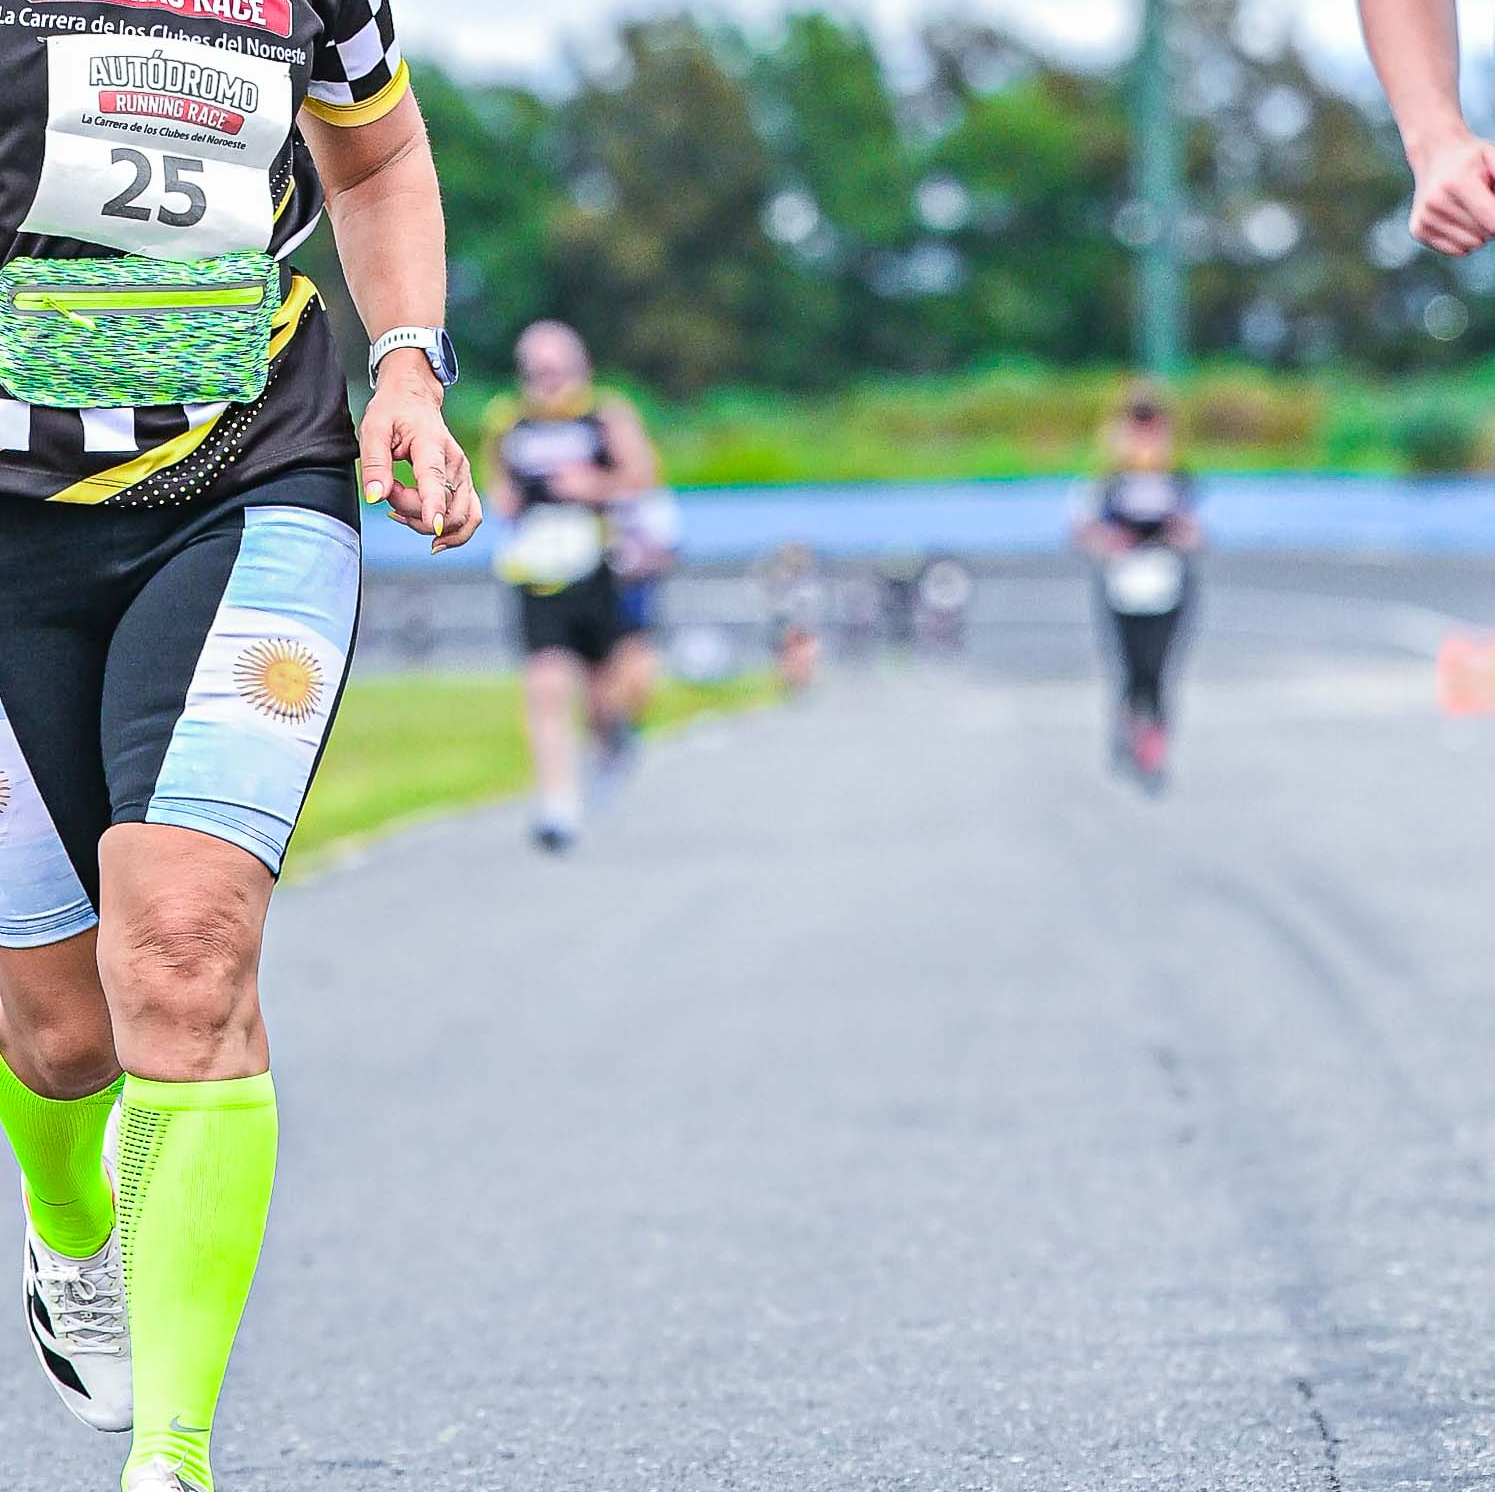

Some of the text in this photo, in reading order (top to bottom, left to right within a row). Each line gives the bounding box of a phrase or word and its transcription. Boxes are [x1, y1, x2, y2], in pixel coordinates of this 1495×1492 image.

[18, 8, 87, 31] Carrera
[90, 16, 114, 34] de
[119, 19, 146, 37] los
[215, 33, 242, 53] del
[246, 38, 306, 65] Noroeste
[89, 49, 258, 113] AUTÓDROMO
[81, 113, 247, 150] La Carrera de los Clubes del Noroeste
[116, 94, 229, 130] RUNNING RACE
[101, 148, 207, 227] 25
